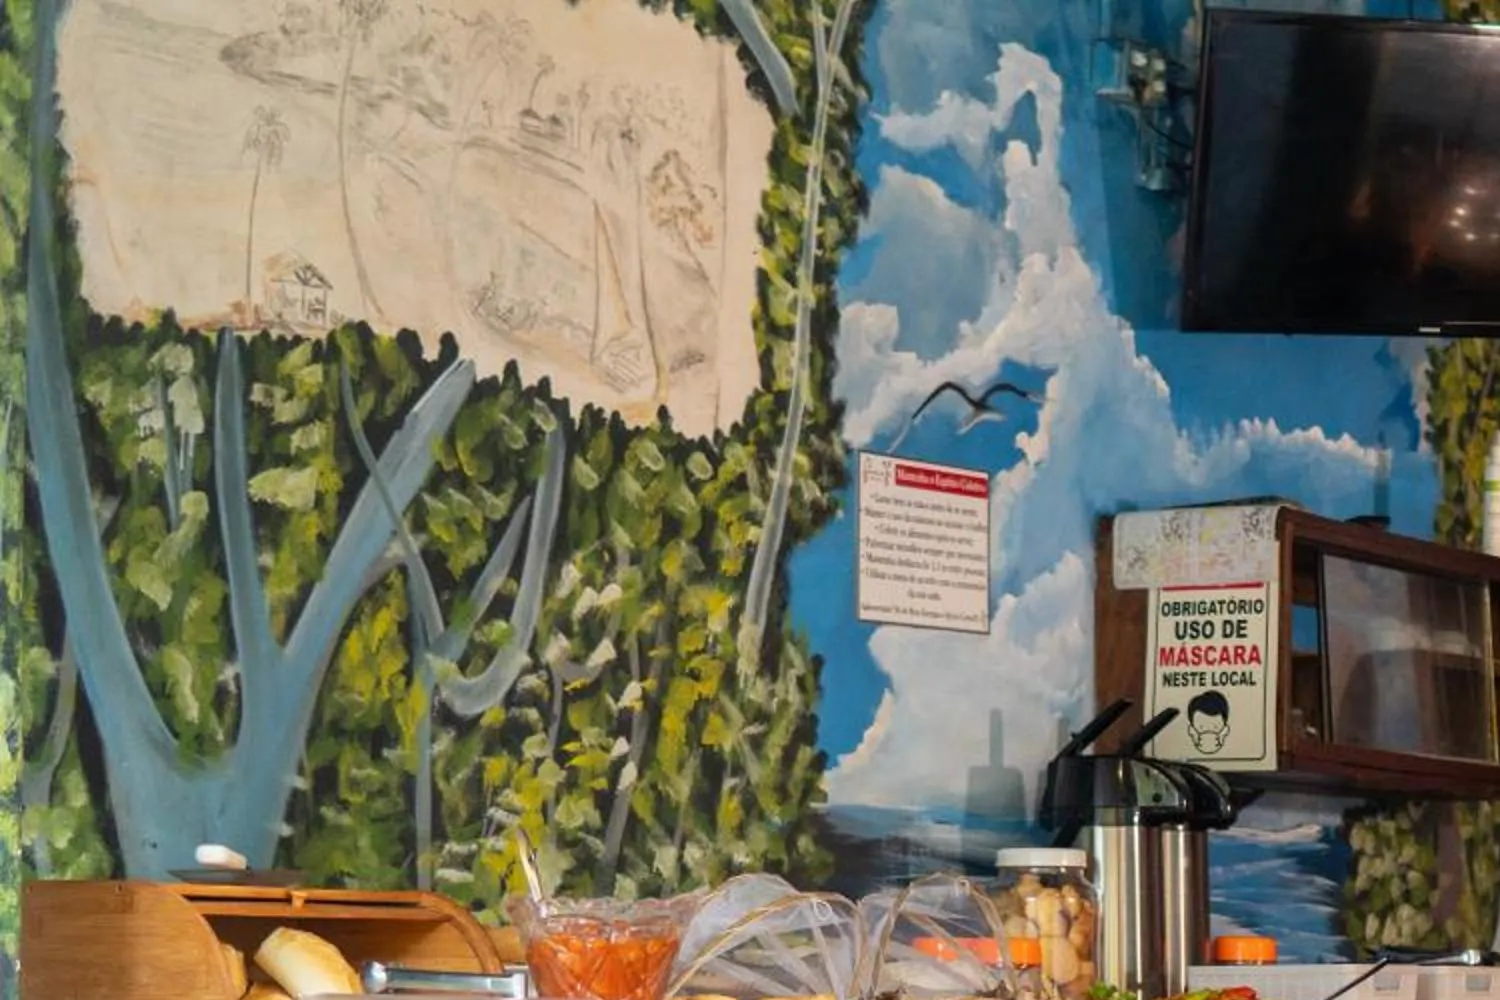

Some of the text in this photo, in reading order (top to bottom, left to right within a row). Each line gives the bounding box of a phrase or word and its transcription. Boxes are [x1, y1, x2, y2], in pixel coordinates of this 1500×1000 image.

[1161, 596, 1264, 617] OBRIGATÓRIO
[1174, 619, 1248, 640] USO DE
[1159, 642, 1262, 667] MÁSCARA
[1162, 670, 1256, 687] NESTE LOCAL
